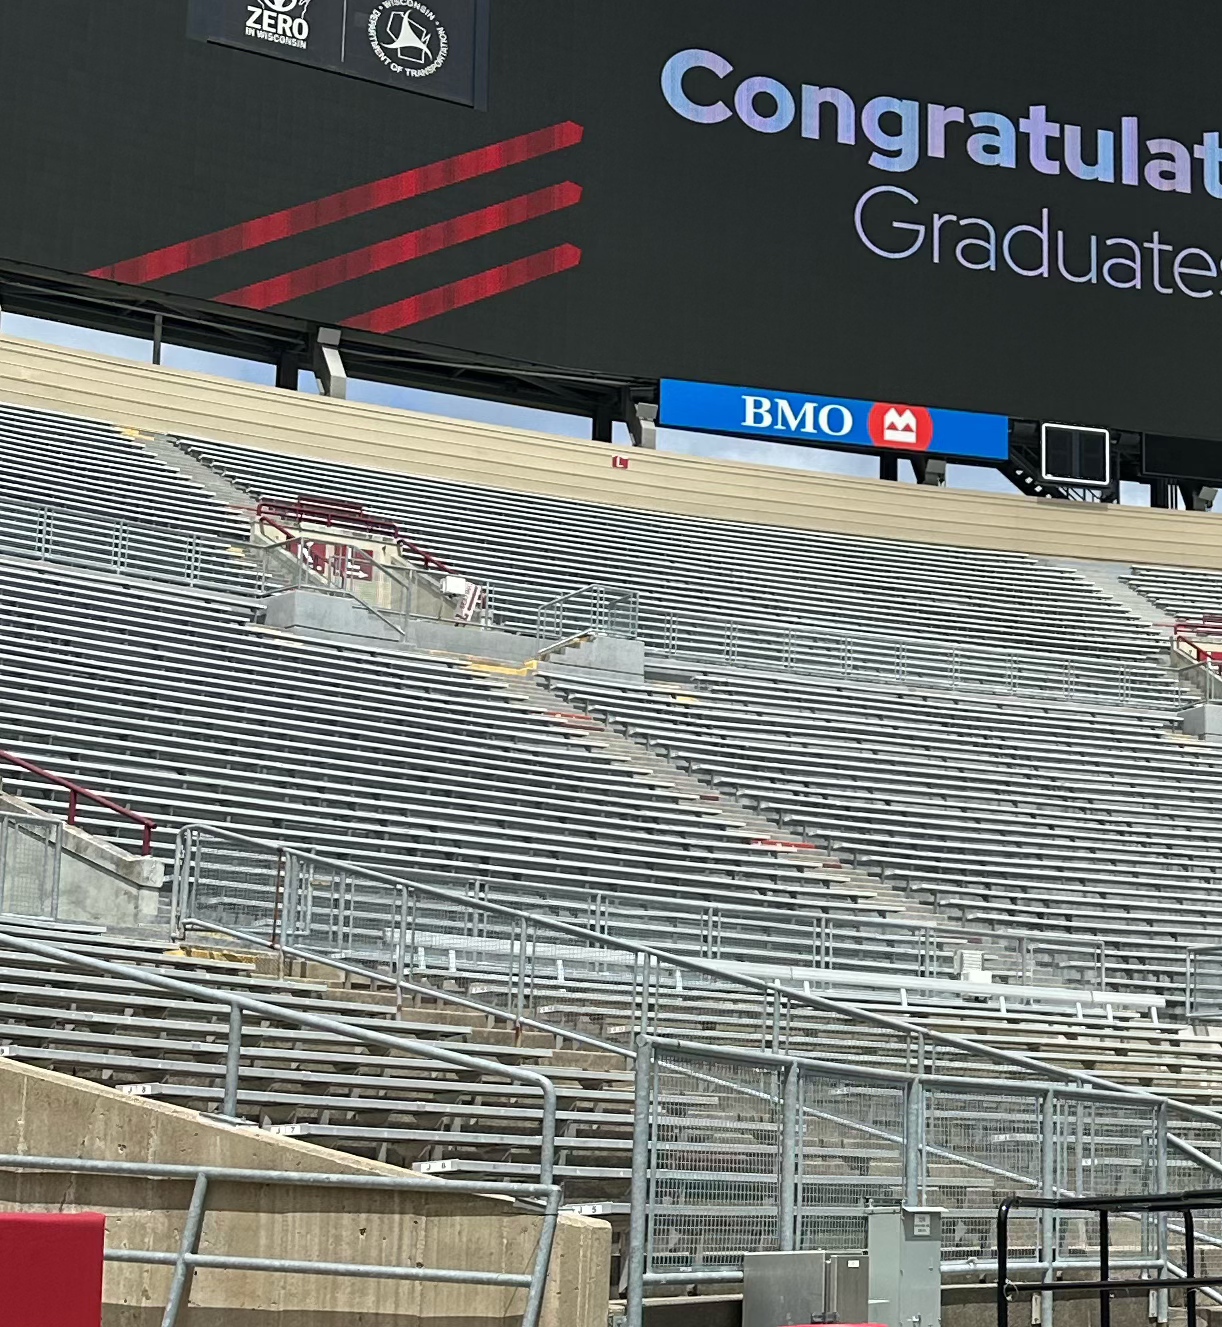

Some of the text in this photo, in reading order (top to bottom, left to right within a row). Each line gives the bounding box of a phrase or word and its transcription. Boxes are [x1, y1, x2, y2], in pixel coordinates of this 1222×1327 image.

[245, 5, 309, 40] ZERO
[245, 26, 307, 49] IN WISCONSIN
[390, 62, 404, 74] OF
[740, 394, 853, 436] BMO
